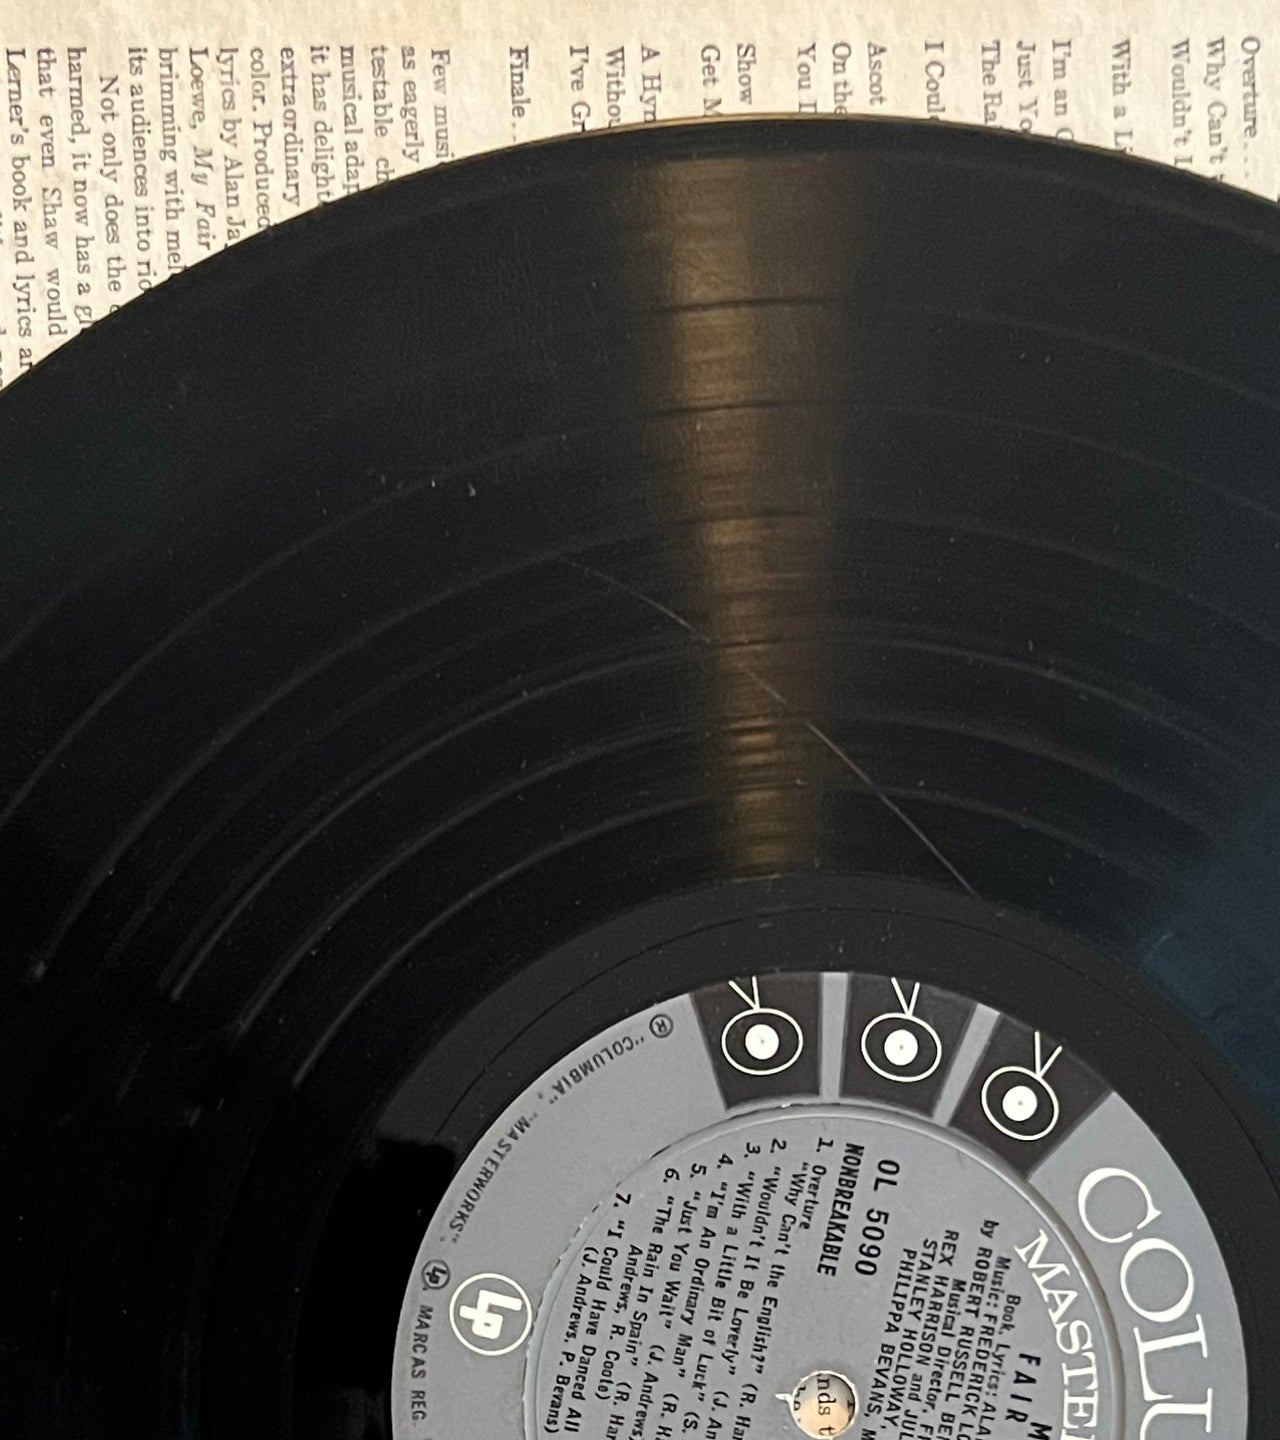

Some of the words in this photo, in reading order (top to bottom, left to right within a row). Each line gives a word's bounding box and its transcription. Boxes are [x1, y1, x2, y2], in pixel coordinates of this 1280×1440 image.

[37, 48, 55, 97] that
[736, 43, 756, 104] Show
[867, 42, 887, 105] Ascot
[1204, 36, 1225, 90] Why
[188, 47, 208, 130] Loewe,
[1171, 39, 1192, 146] Wouldn't
[40, 115, 56, 168] even
[280, 47, 303, 206] extraordinary
[1207, 100, 1228, 164] Can't
[191, 148, 213, 184] My
[42, 187, 62, 248] Shaw
[195, 201, 215, 250] Fair
[46, 268, 67, 336] would
[744, 1142, 761, 1158] 3.
[770, 1137, 787, 1153] 2.
[816, 1137, 834, 1152] 1.
[613, 1192, 632, 1207] 7.
[731, 1171, 756, 1219] "With
[784, 1161, 809, 1206] "Why
[799, 1164, 827, 1229] Overture
[873, 1159, 900, 1192] OL
[726, 1226, 738, 1235] a
[774, 1213, 797, 1254] Can't
[817, 1142, 865, 1276] NONBREAKABLE
[980, 1219, 1000, 1239] by
[715, 1244, 739, 1288] Little
[744, 1254, 761, 1270] It
[855, 1208, 890, 1275] 5090
[938, 1229, 960, 1266] REX
[596, 1246, 619, 1291] Could
[737, 1279, 755, 1299] Be
[767, 1264, 786, 1288] the
[884, 1248, 918, 1333] PHILIPPA
[908, 1238, 938, 1321] STANLEY
[965, 1246, 993, 1318] ROBERT
[986, 1256, 1012, 1308] Music:
[586, 1299, 608, 1335] Have
[707, 1296, 727, 1321] Bit
[915, 1275, 950, 1366] HARRISON
[411, 1304, 434, 1379] MARCAS
[702, 1329, 717, 1346] of
[571, 1344, 597, 1400] Danced
[863, 1343, 896, 1417] BEVANS,
[880, 1328, 919, 1429] HOLLOWAY,
[908, 1373, 923, 1402] and
[945, 1325, 975, 1402] RUSSELL
[961, 1313, 998, 1417] FREDERICK
[1005, 1353, 1042, 1423] FAIR
[564, 1407, 582, 1432] All
[739, 1383, 759, 1407] (R.
[817, 1375, 836, 1415] nds
[682, 1411, 700, 1433] (S.
